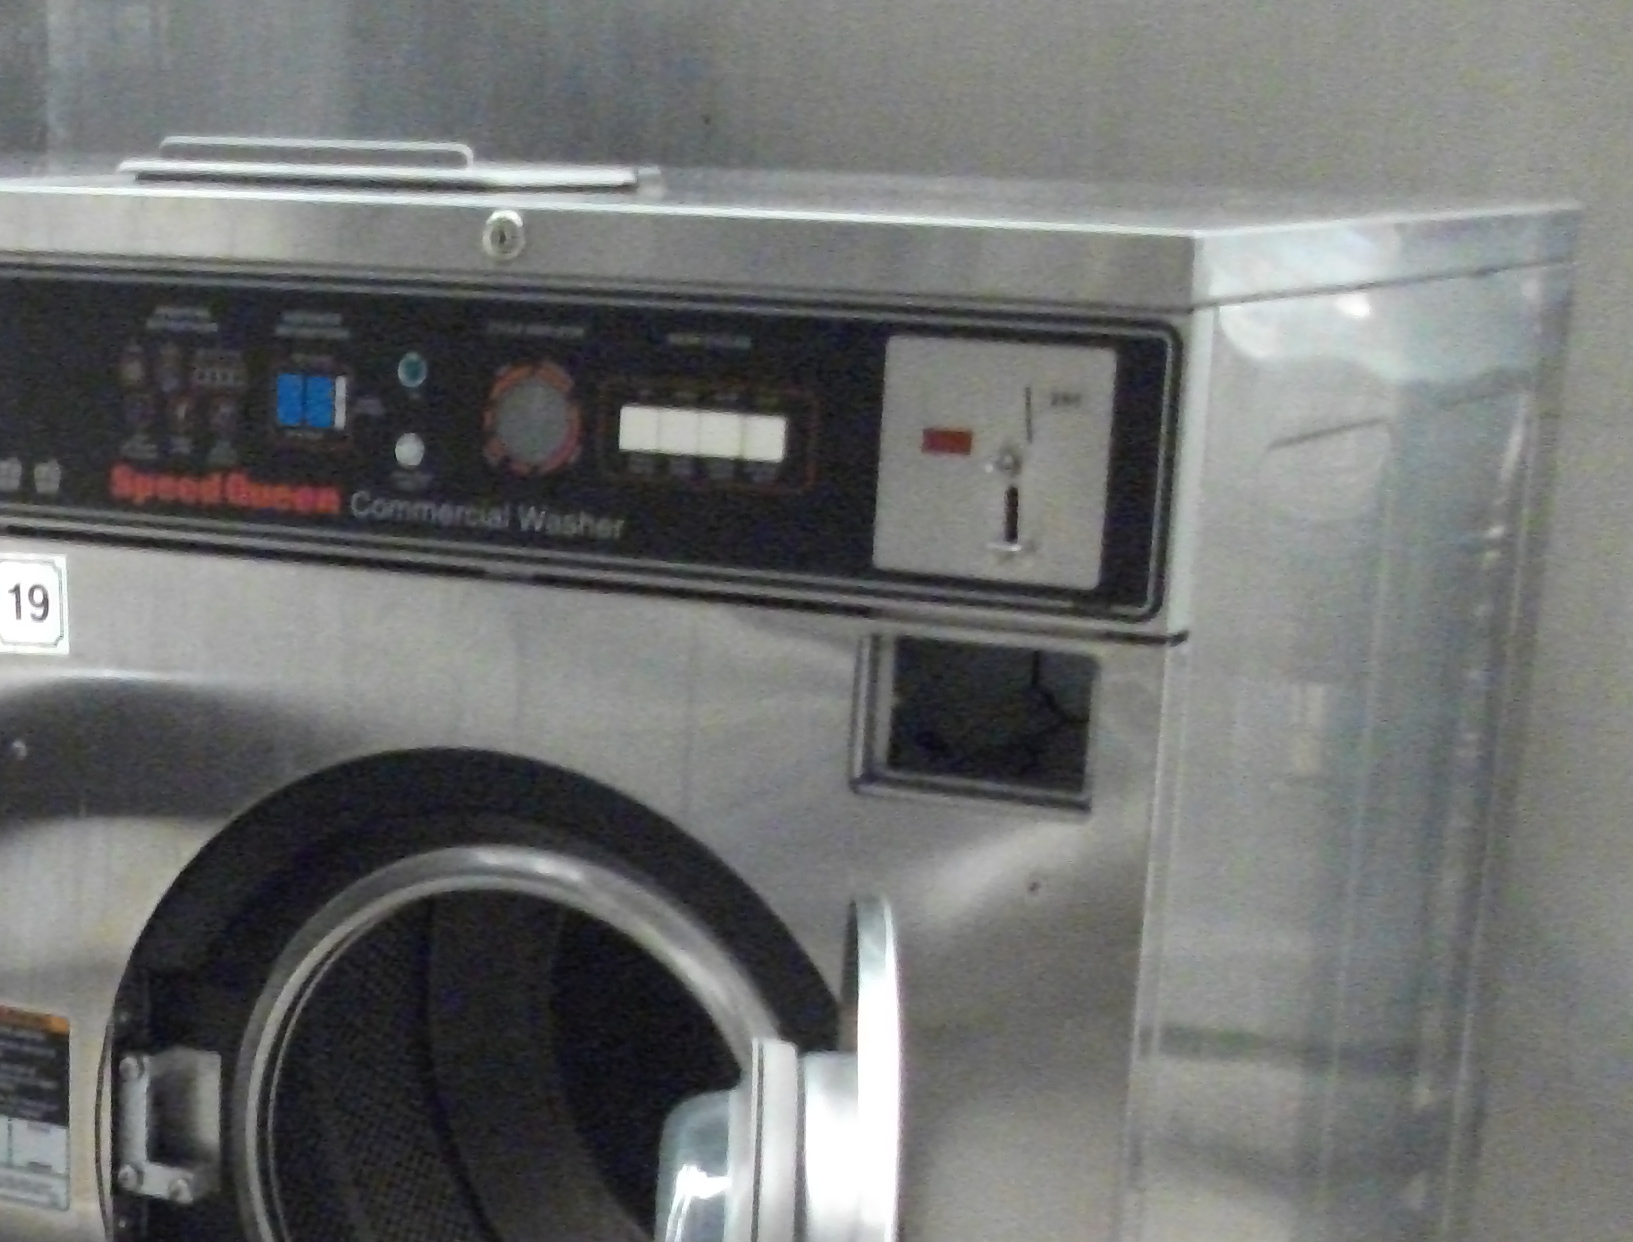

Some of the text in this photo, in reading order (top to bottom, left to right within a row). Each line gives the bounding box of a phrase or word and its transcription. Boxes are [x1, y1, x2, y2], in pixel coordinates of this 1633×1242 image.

[110, 470, 222, 506] Speed
[351, 490, 510, 529] Commercial
[518, 504, 625, 539] Washer
[8, 583, 49, 623] 19
